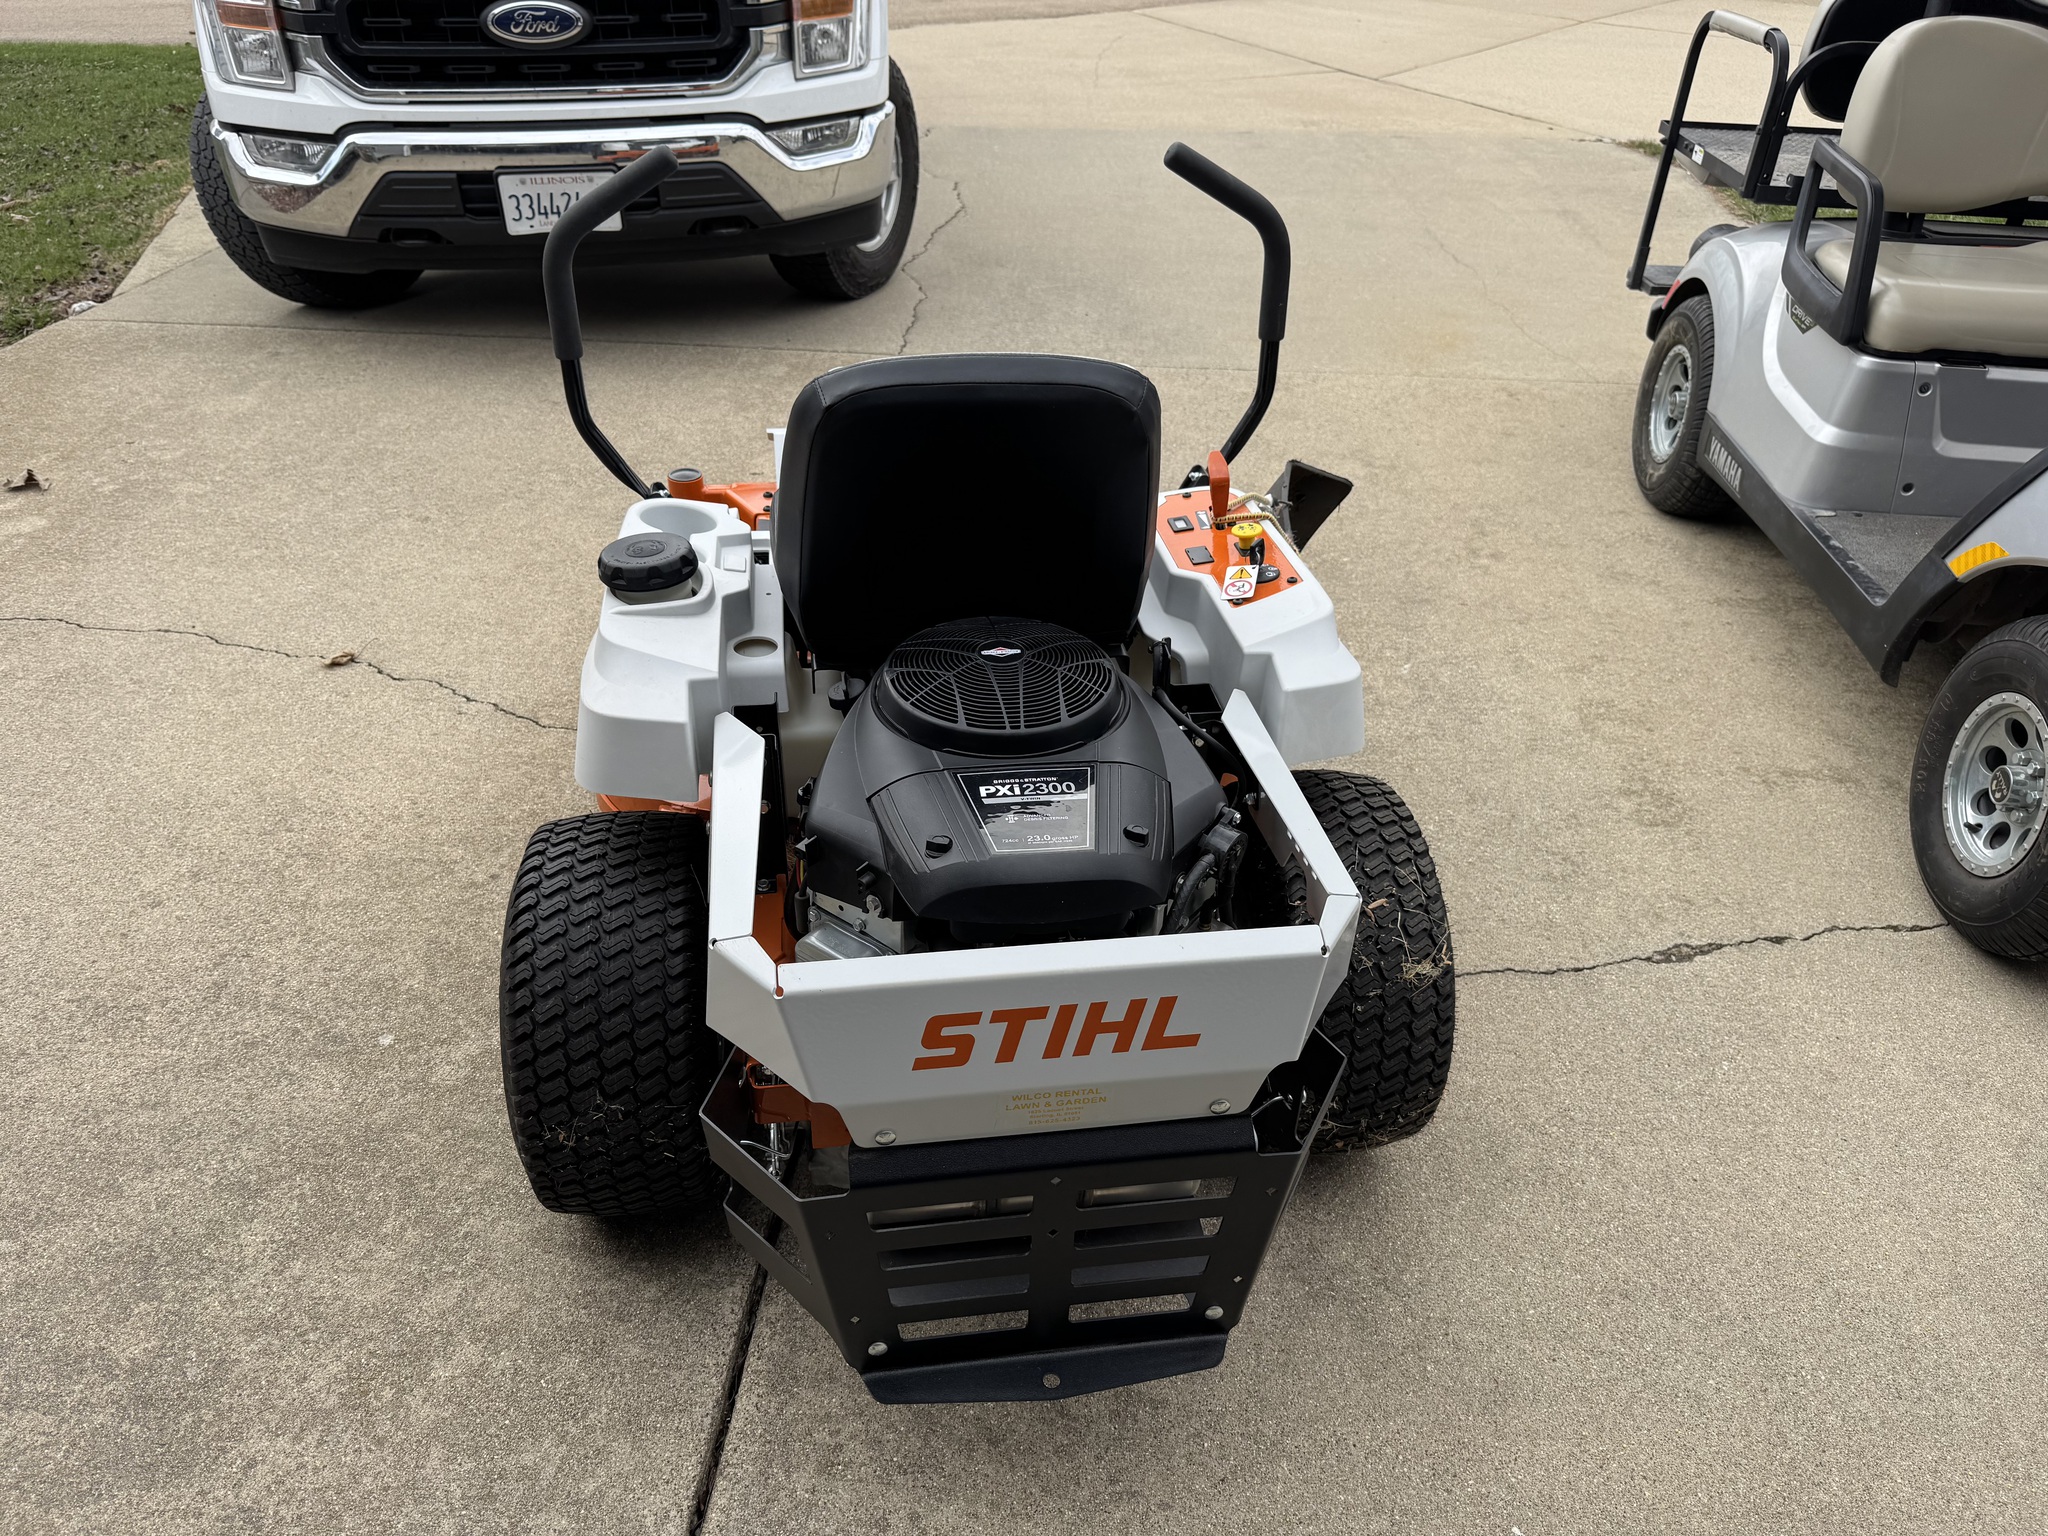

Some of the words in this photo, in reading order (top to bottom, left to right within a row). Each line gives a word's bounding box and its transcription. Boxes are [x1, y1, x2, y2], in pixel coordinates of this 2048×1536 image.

[510, 10, 560, 33] Ford
[529, 176, 586, 186] ILLINOIS
[508, 191, 580, 222] 33442
[1709, 435, 1742, 492] YAMAHA
[1026, 834, 1051, 842] 23.0
[912, 995, 1201, 1071] STIHL
[1005, 1101, 1040, 1111] LAWN
[1044, 1100, 1052, 1108] &
[1056, 1096, 1107, 1107] GARDEN
[1011, 1092, 1051, 1102] WILCO
[1055, 1087, 1102, 1098] RENTAL
